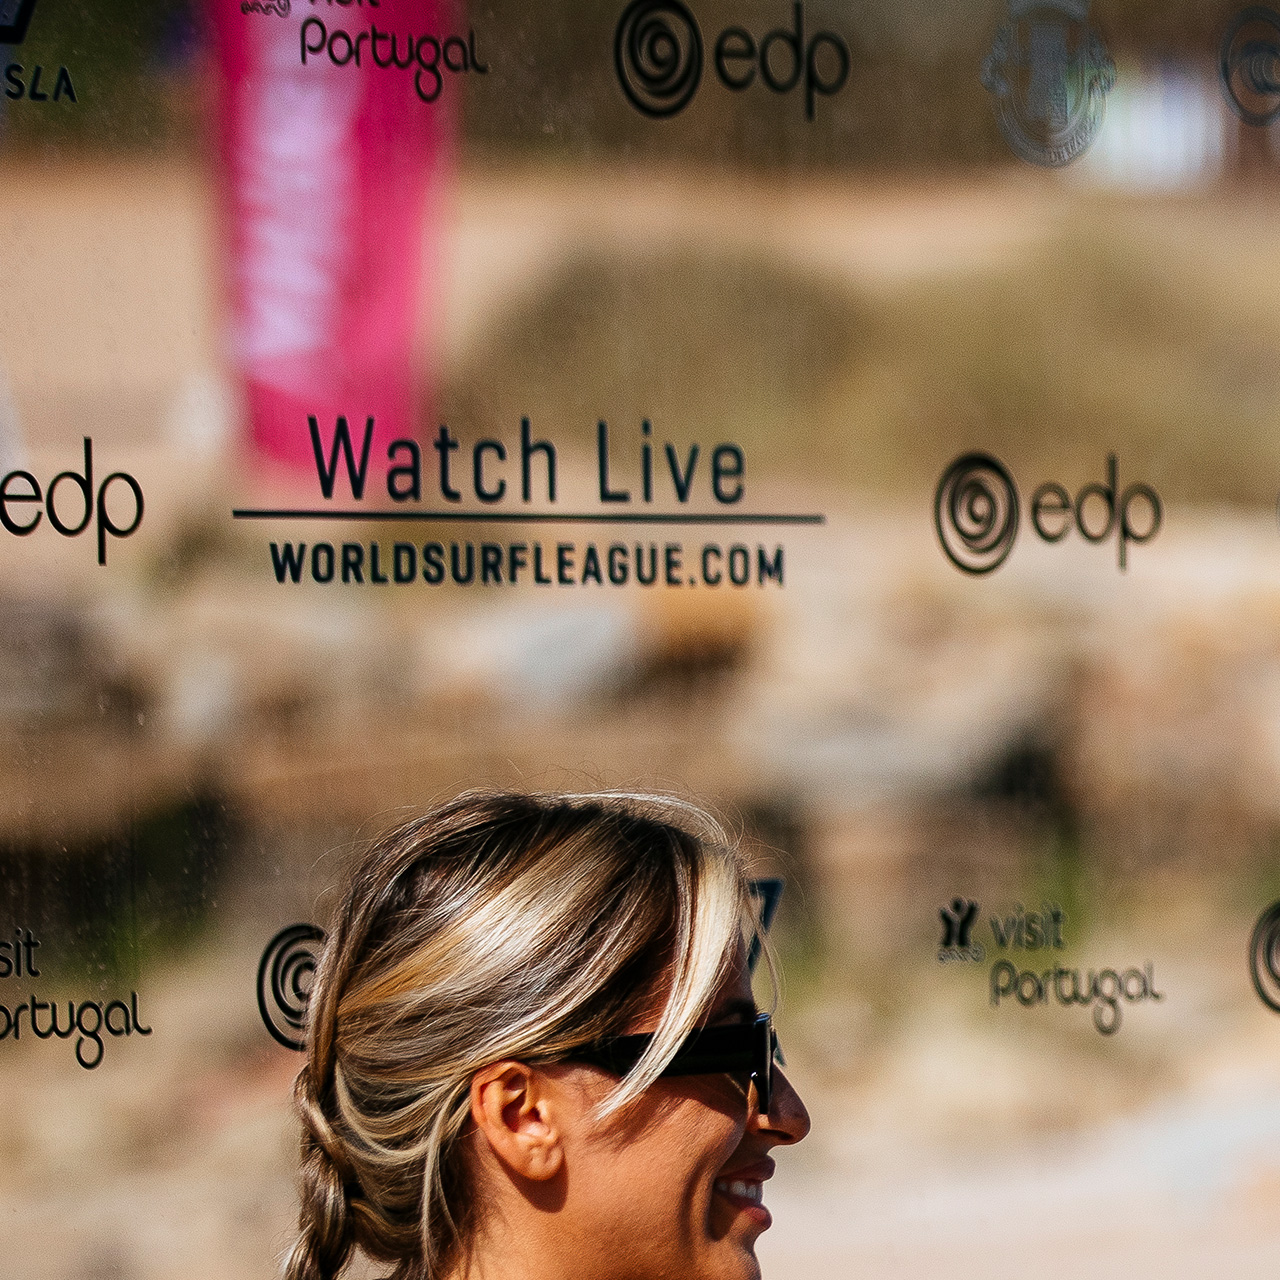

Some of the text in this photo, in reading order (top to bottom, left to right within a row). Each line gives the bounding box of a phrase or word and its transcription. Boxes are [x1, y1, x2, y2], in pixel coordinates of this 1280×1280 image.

[301, 17, 489, 103] Portugal
[715, 0, 849, 121] edp
[0, 437, 144, 567] edp
[308, 415, 746, 506] Watch Live
[1030, 453, 1163, 571] edp
[269, 541, 785, 589] WORLDSURFLEAGUE.COM
[990, 902, 1067, 951] visit
[990, 958, 1164, 1036] Portugal
